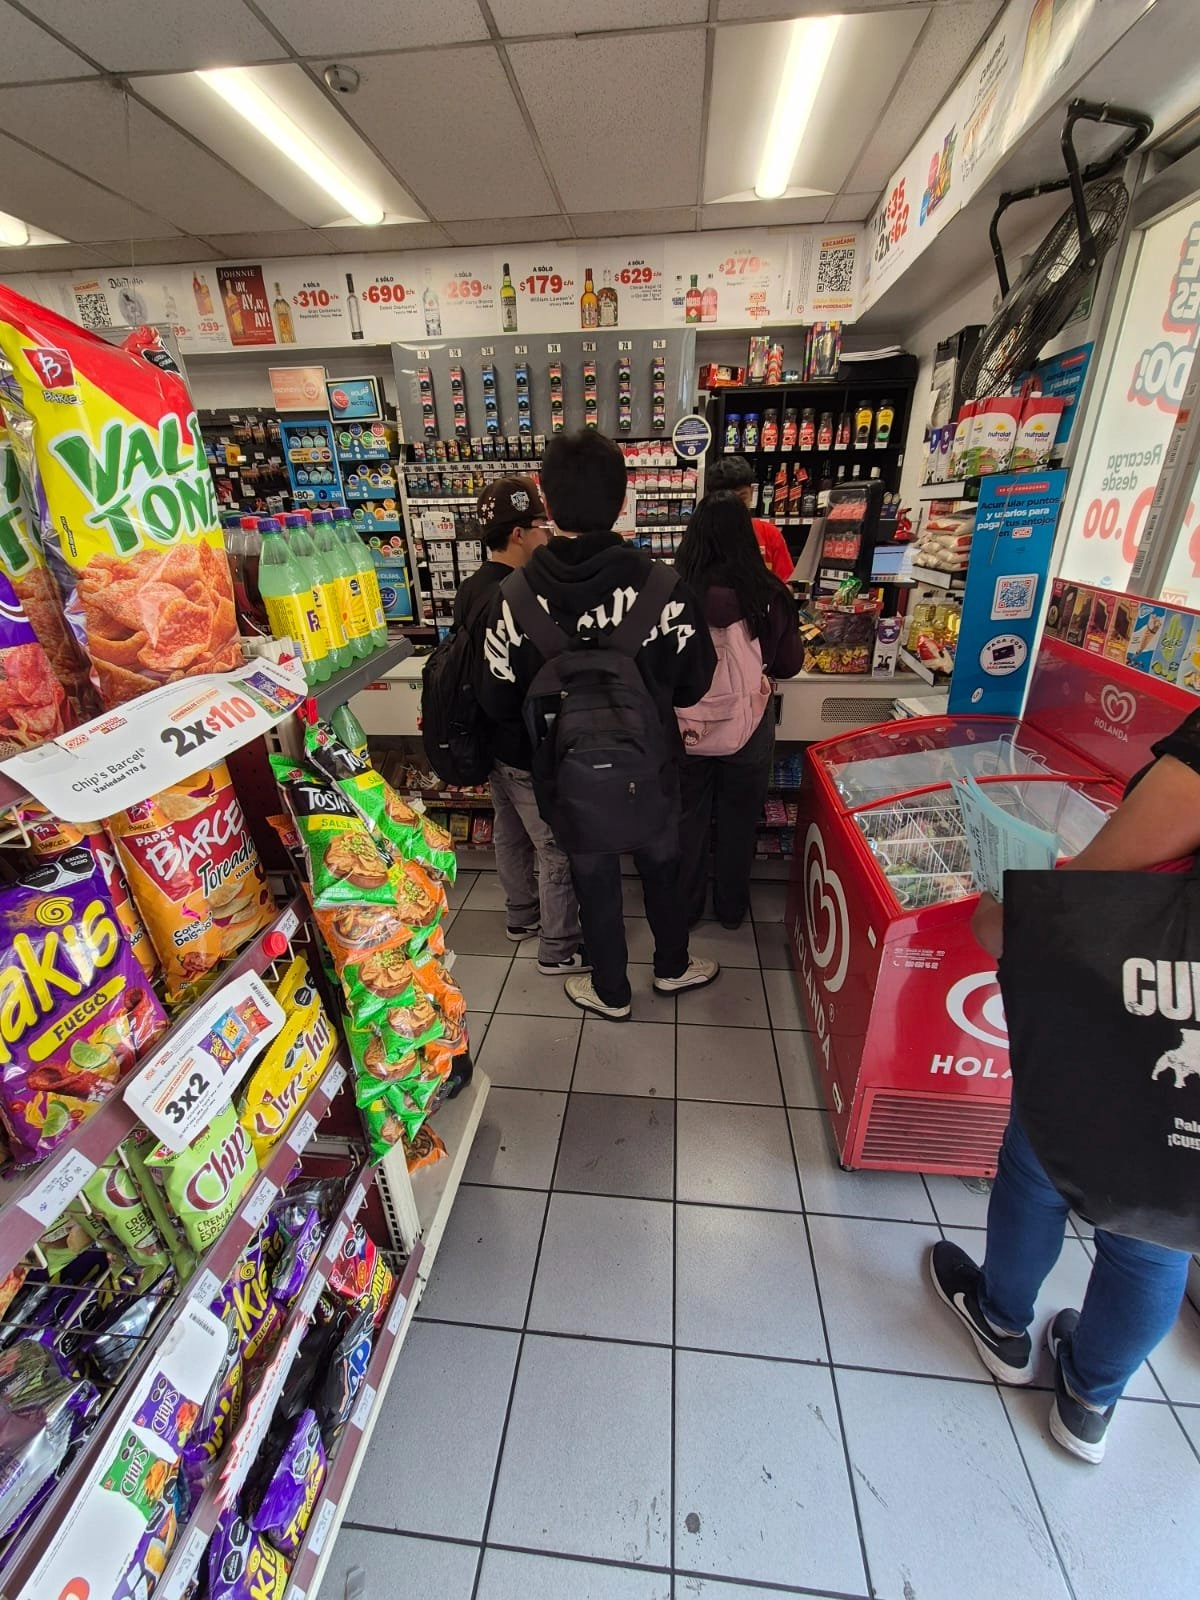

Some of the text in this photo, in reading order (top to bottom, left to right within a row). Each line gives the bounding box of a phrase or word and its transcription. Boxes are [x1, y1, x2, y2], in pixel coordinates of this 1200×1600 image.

[220, 268, 256, 279] JOHNNIE
[520, 274, 563, 294] $179
[614, 267, 653, 284] $629
[292, 289, 330, 307] $310
[362, 284, 406, 303] $690
[1028, 508, 1050, 517] para
[977, 521, 1004, 531] pagar
[160, 696, 257, 758] 2x$110
[1094, 716, 1129, 743] HOLANDA
[72, 766, 108, 793] Chip's
[92, 773, 126, 794] Variedad
[126, 766, 139, 778] 170
[136, 826, 175, 846] PAPAS
[174, 918, 201, 940] Corte
[794, 915, 830, 1071] HOLANDA
[1122, 957, 1200, 1022] CU
[53, 992, 108, 1041] FUEGO
[164, 1072, 210, 1124] 3x2
